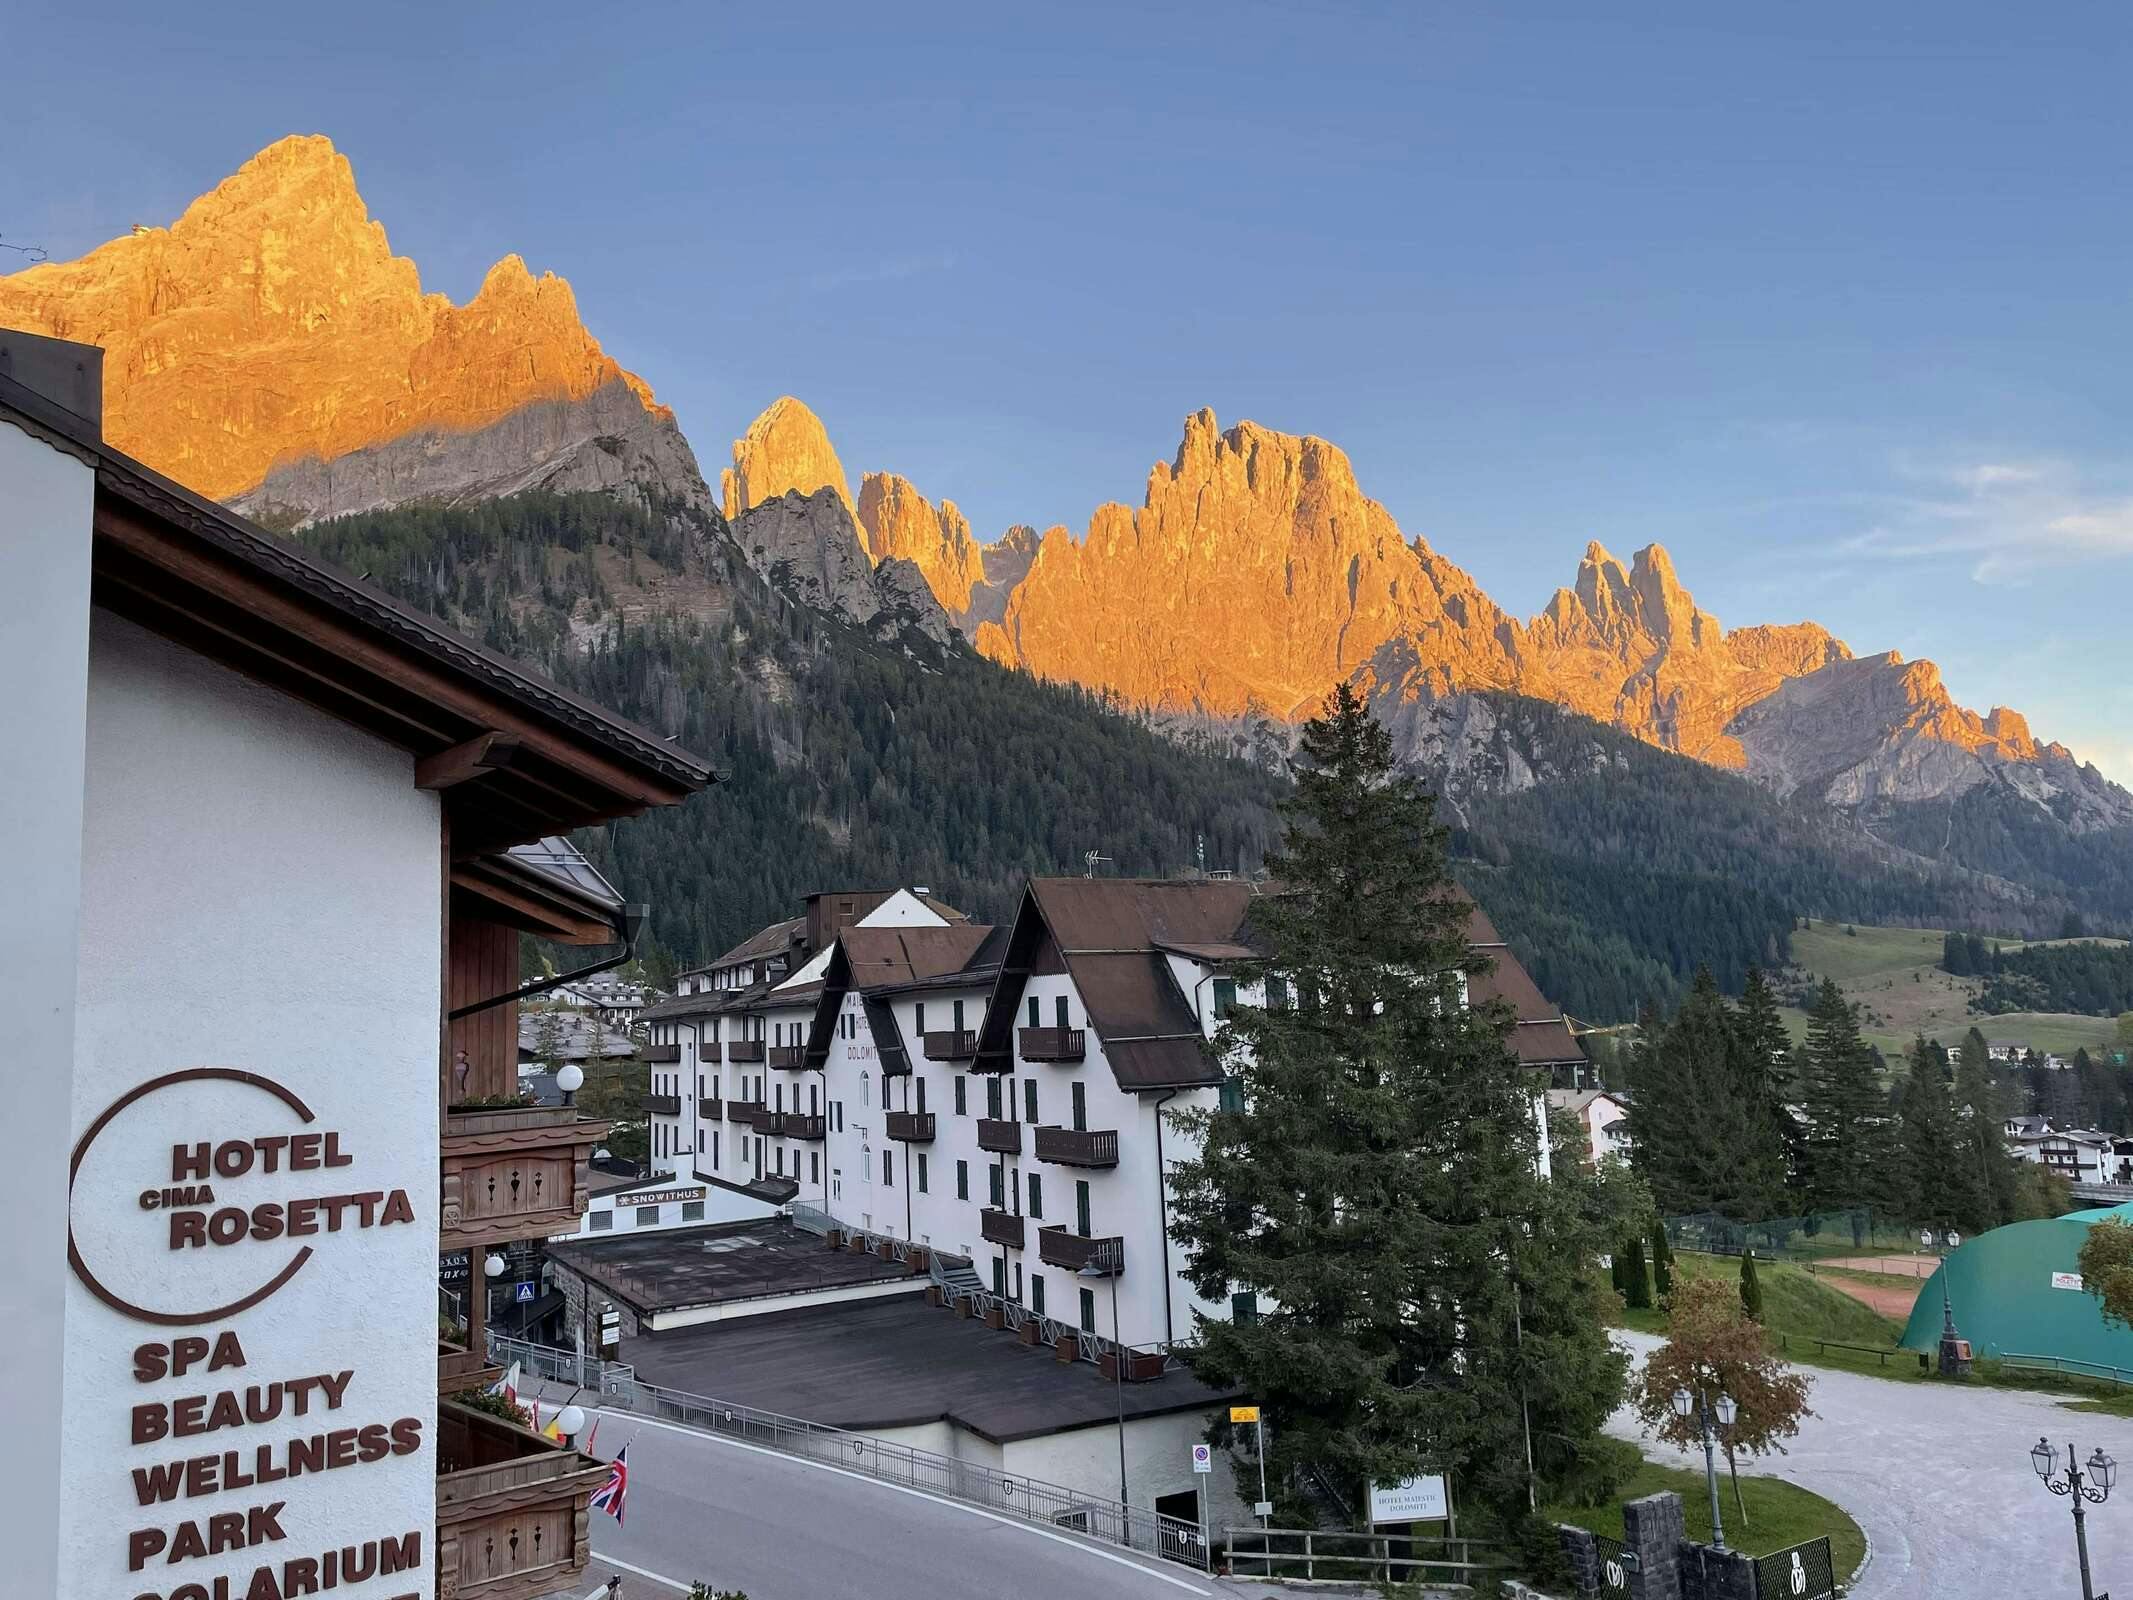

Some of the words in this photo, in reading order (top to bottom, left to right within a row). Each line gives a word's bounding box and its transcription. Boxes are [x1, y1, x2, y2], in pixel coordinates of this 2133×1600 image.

[172, 1132, 353, 1182] HOTEL
[139, 1184, 216, 1210] CIMA
[169, 1189, 415, 1250] ROSETTA
[631, 1189, 700, 1204] SNOWITHUS
[133, 1331, 247, 1383] SPA
[131, 1370, 355, 1445] BEAUTY
[131, 1417, 423, 1506] WELLNESS
[129, 1501, 288, 1572] PARK
[132, 1531, 422, 1600] LARIUM
